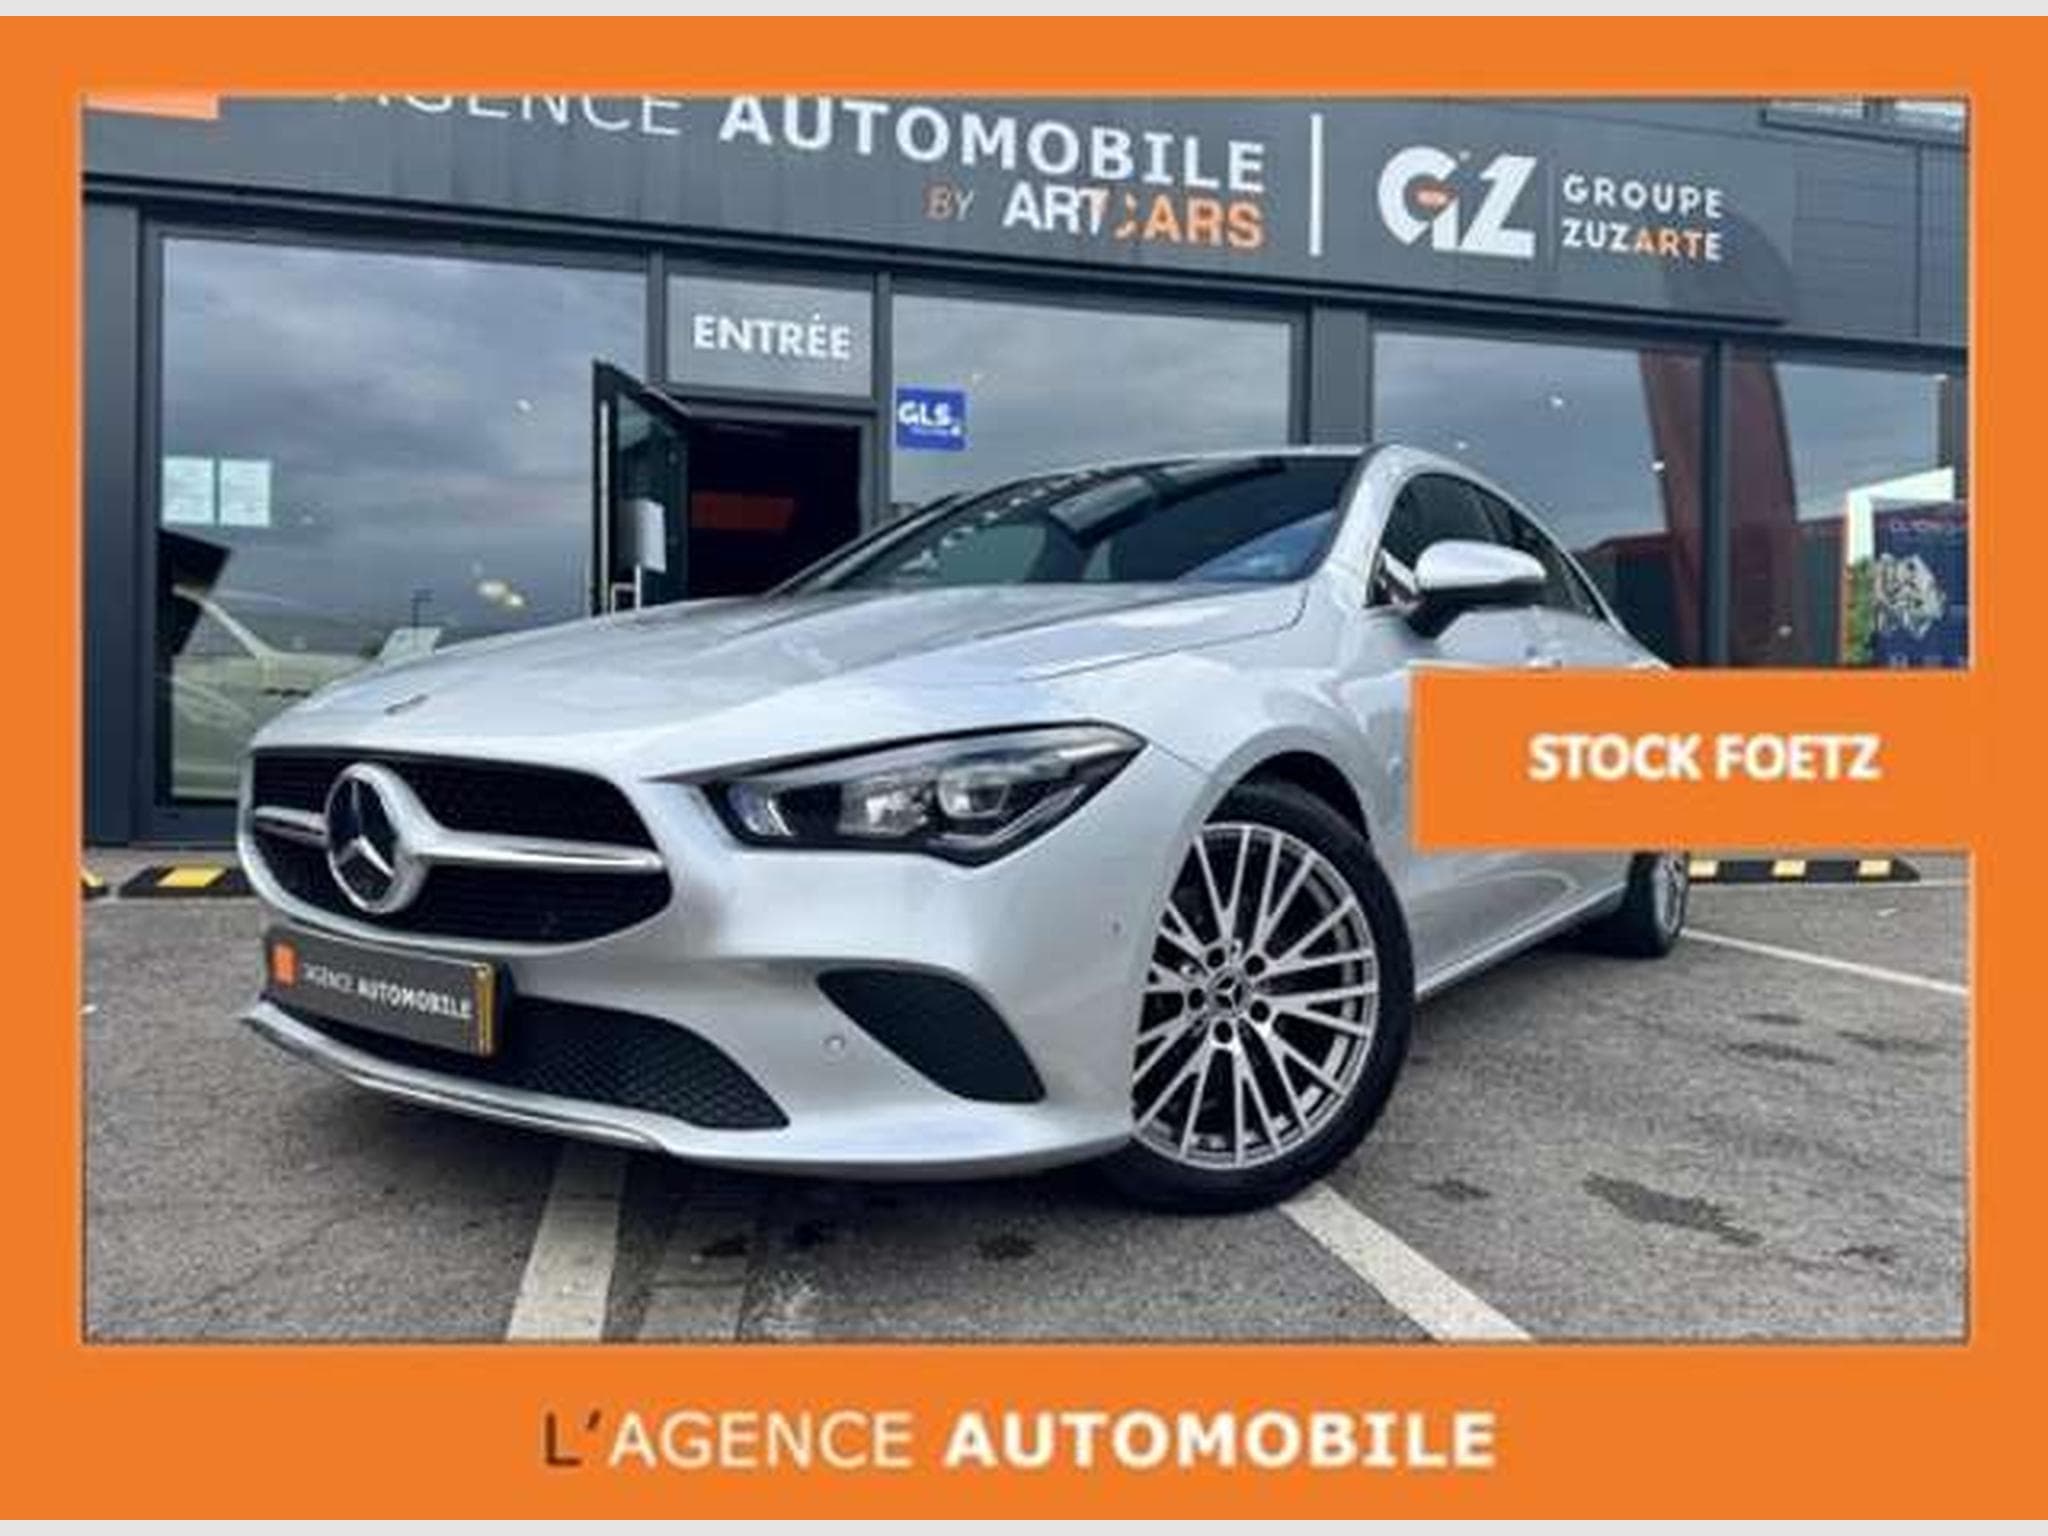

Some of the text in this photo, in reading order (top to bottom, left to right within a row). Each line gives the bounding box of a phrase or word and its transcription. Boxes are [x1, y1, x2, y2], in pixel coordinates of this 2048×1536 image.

[718, 95, 1266, 194] AUTOMOBILE
[926, 183, 975, 221] BY
[1562, 173, 1723, 220] GROUPE
[1561, 218, 1723, 261] ZUZARTE
[694, 313, 850, 360] ENTRÉE
[357, 977, 473, 1020] AUTOMOBILE
